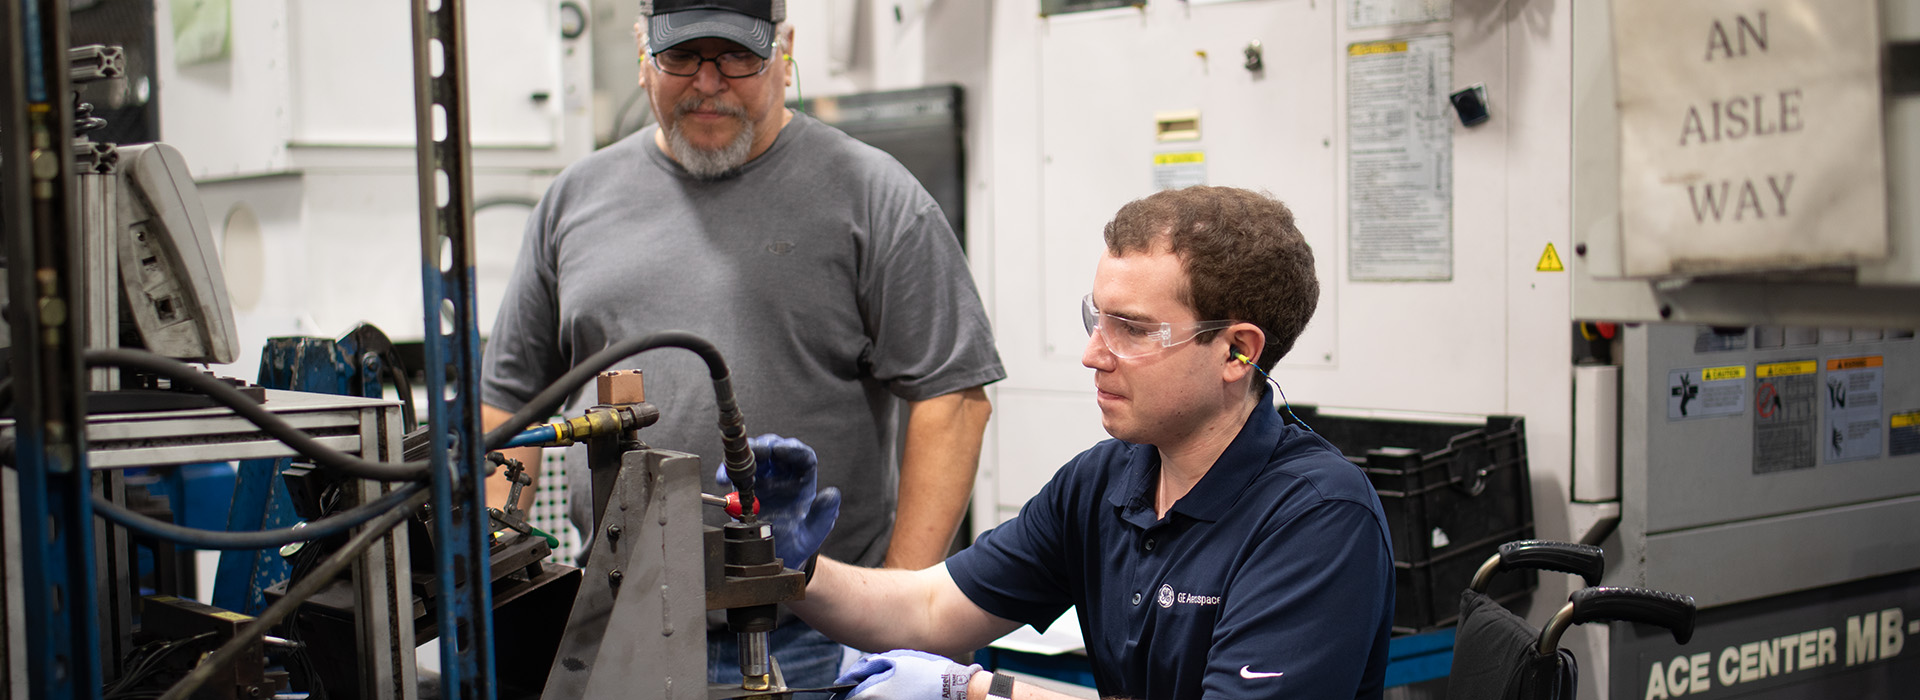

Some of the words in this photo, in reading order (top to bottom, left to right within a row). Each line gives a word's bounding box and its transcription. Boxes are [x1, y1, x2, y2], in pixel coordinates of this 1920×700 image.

[1703, 10, 1770, 61] AN
[1678, 88, 1804, 147] AISLE
[1686, 173, 1795, 225] WAY
[1177, 592, 1186, 603] GE
[1644, 652, 1711, 700] ACE
[1717, 627, 1837, 687] CENTER
